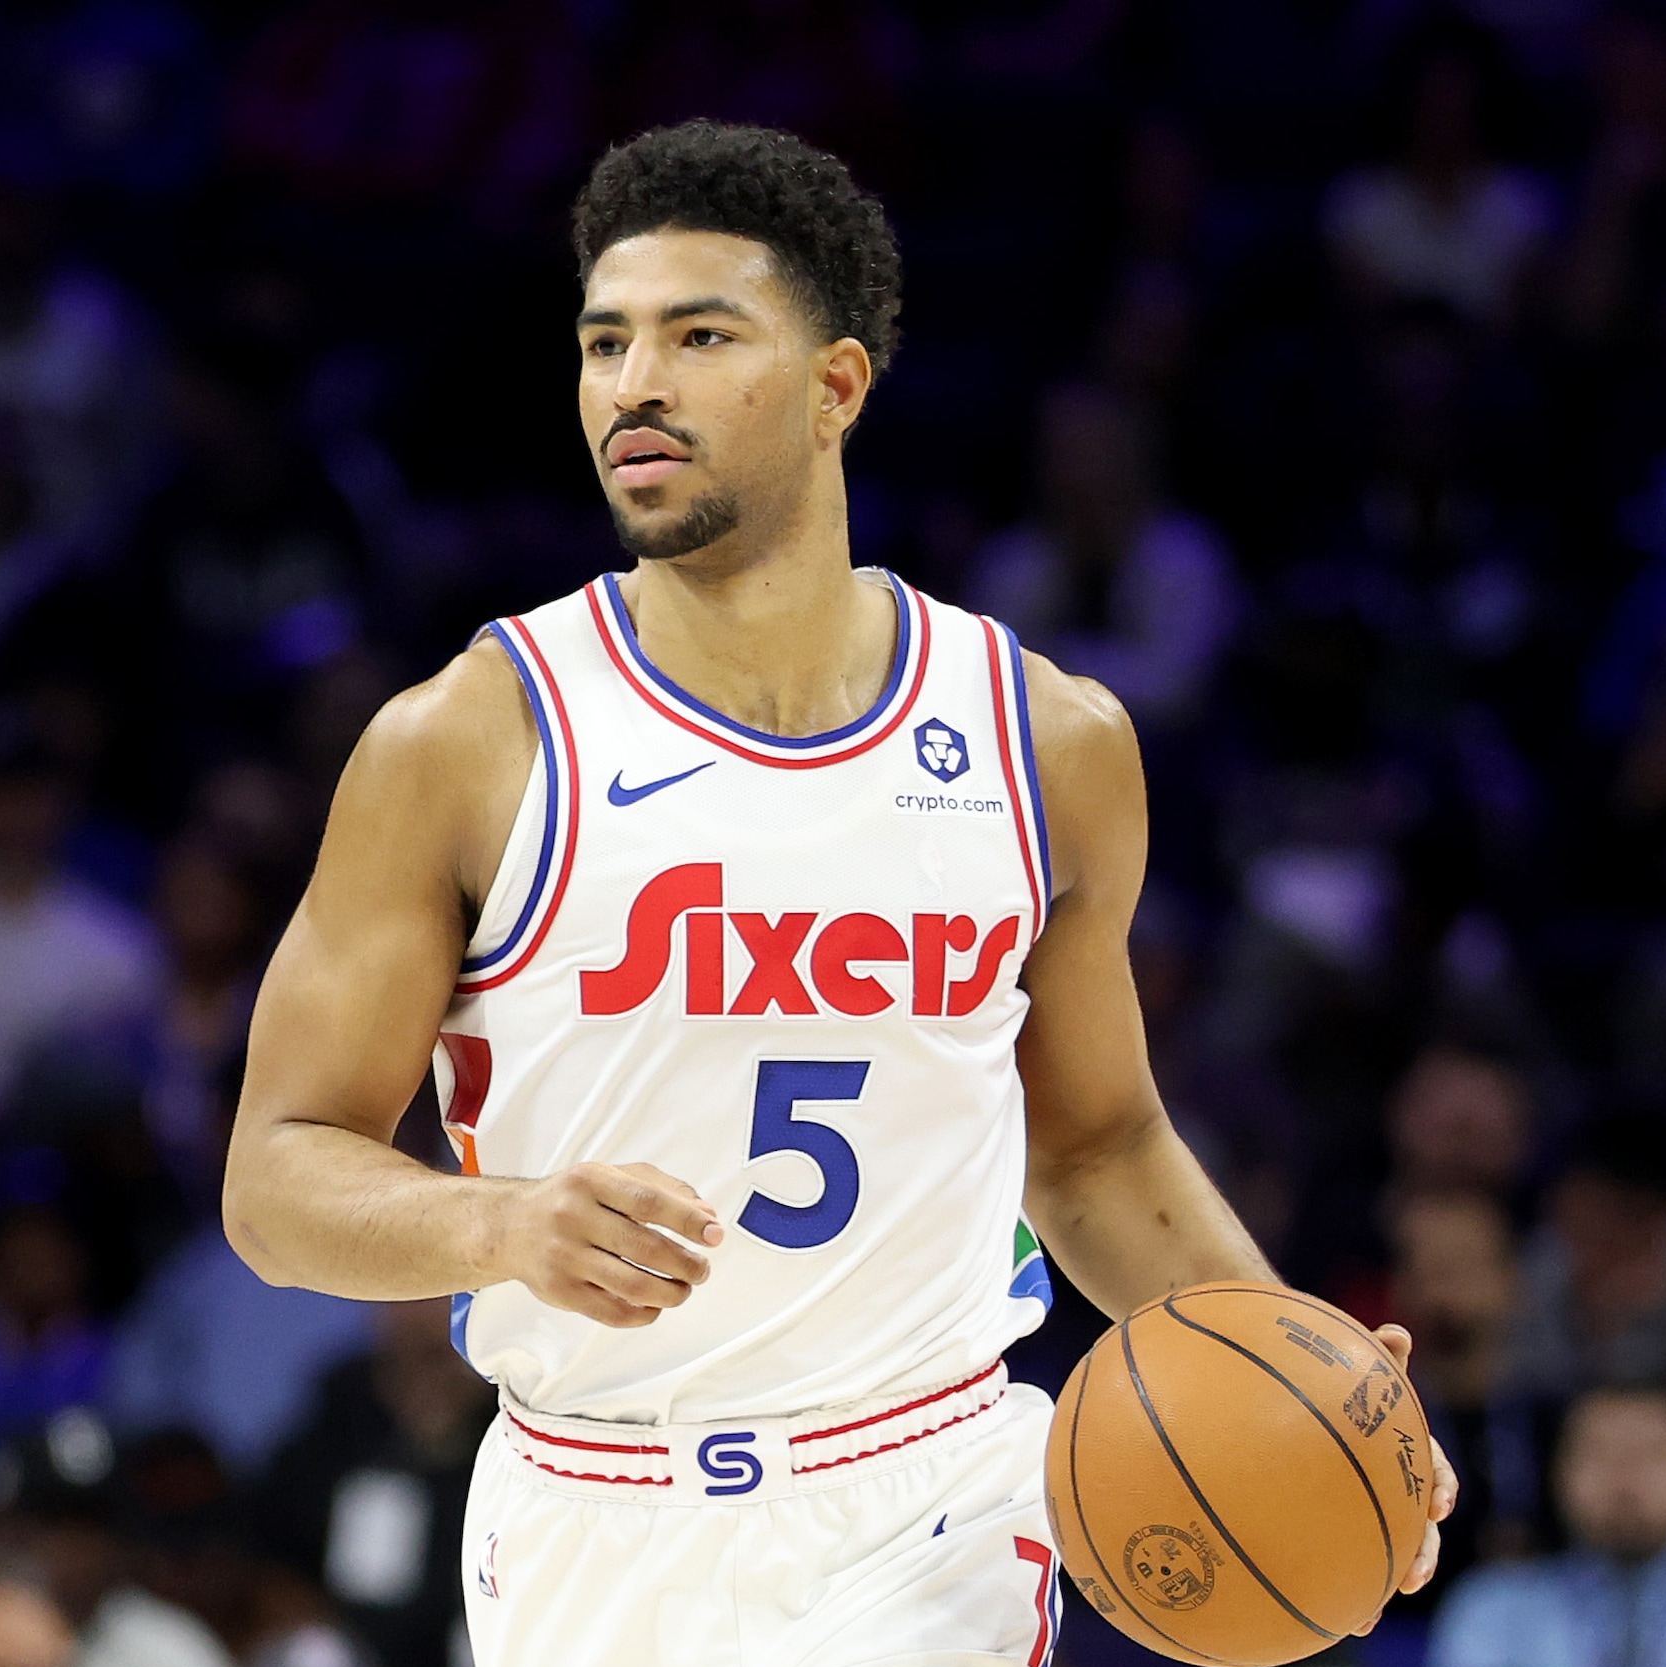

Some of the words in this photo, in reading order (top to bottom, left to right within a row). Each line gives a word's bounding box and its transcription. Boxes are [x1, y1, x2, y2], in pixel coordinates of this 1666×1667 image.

[895, 795, 1004, 813] crypto.com
[578, 862, 1020, 1016] Sixers
[737, 1060, 871, 1249] 5
